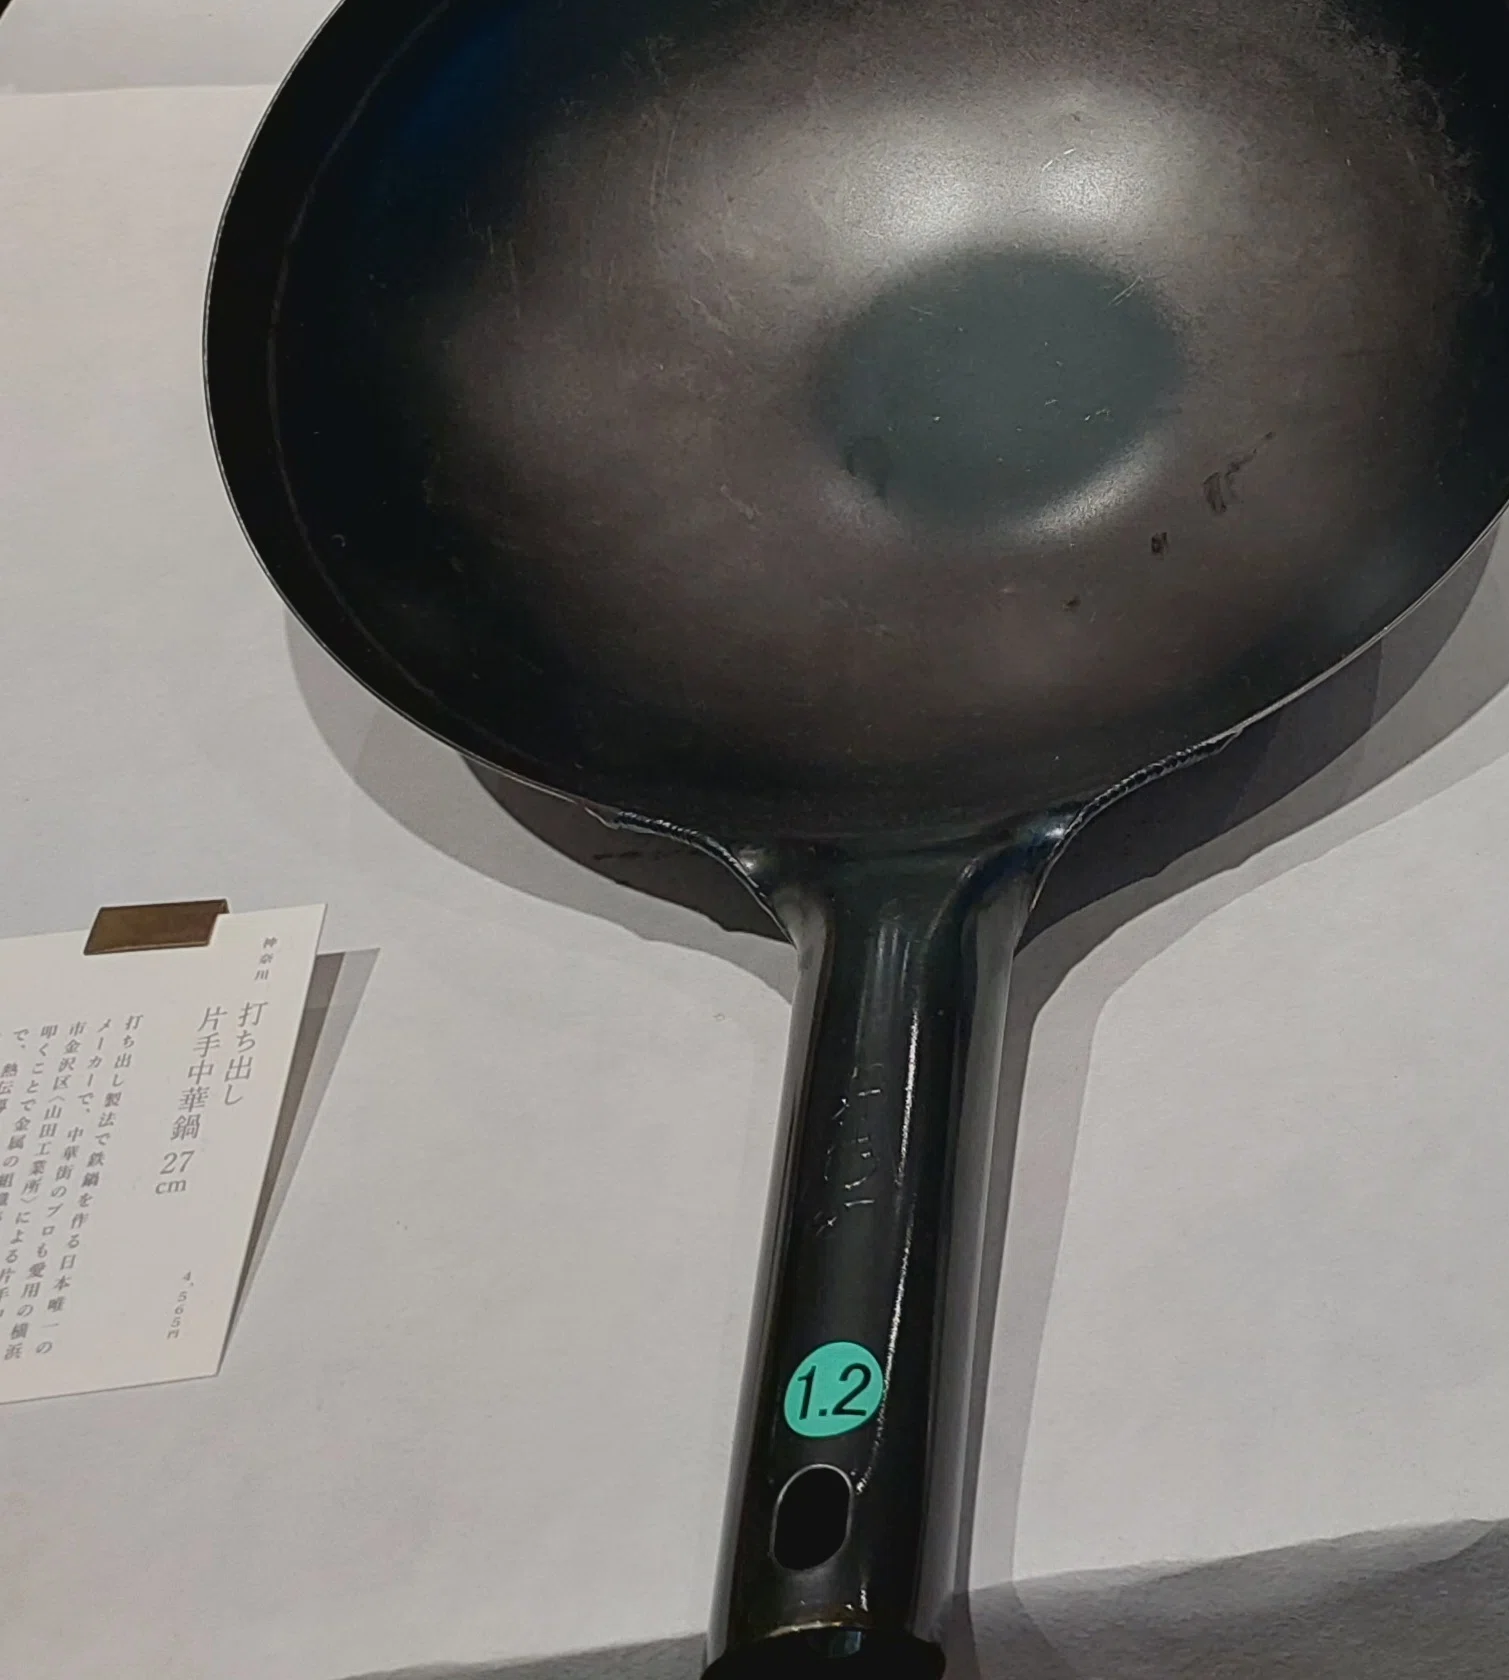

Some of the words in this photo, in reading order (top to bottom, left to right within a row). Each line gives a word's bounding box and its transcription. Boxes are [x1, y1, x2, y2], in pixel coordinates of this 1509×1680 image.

[254, 937, 277, 981] 神奈川
[170, 1006, 228, 1141] 片手中華鍋
[223, 1001, 268, 1106] 打ち出し
[155, 1179, 187, 1194] cm
[160, 1150, 194, 1175] 27
[797, 1363, 872, 1420] 1.2
